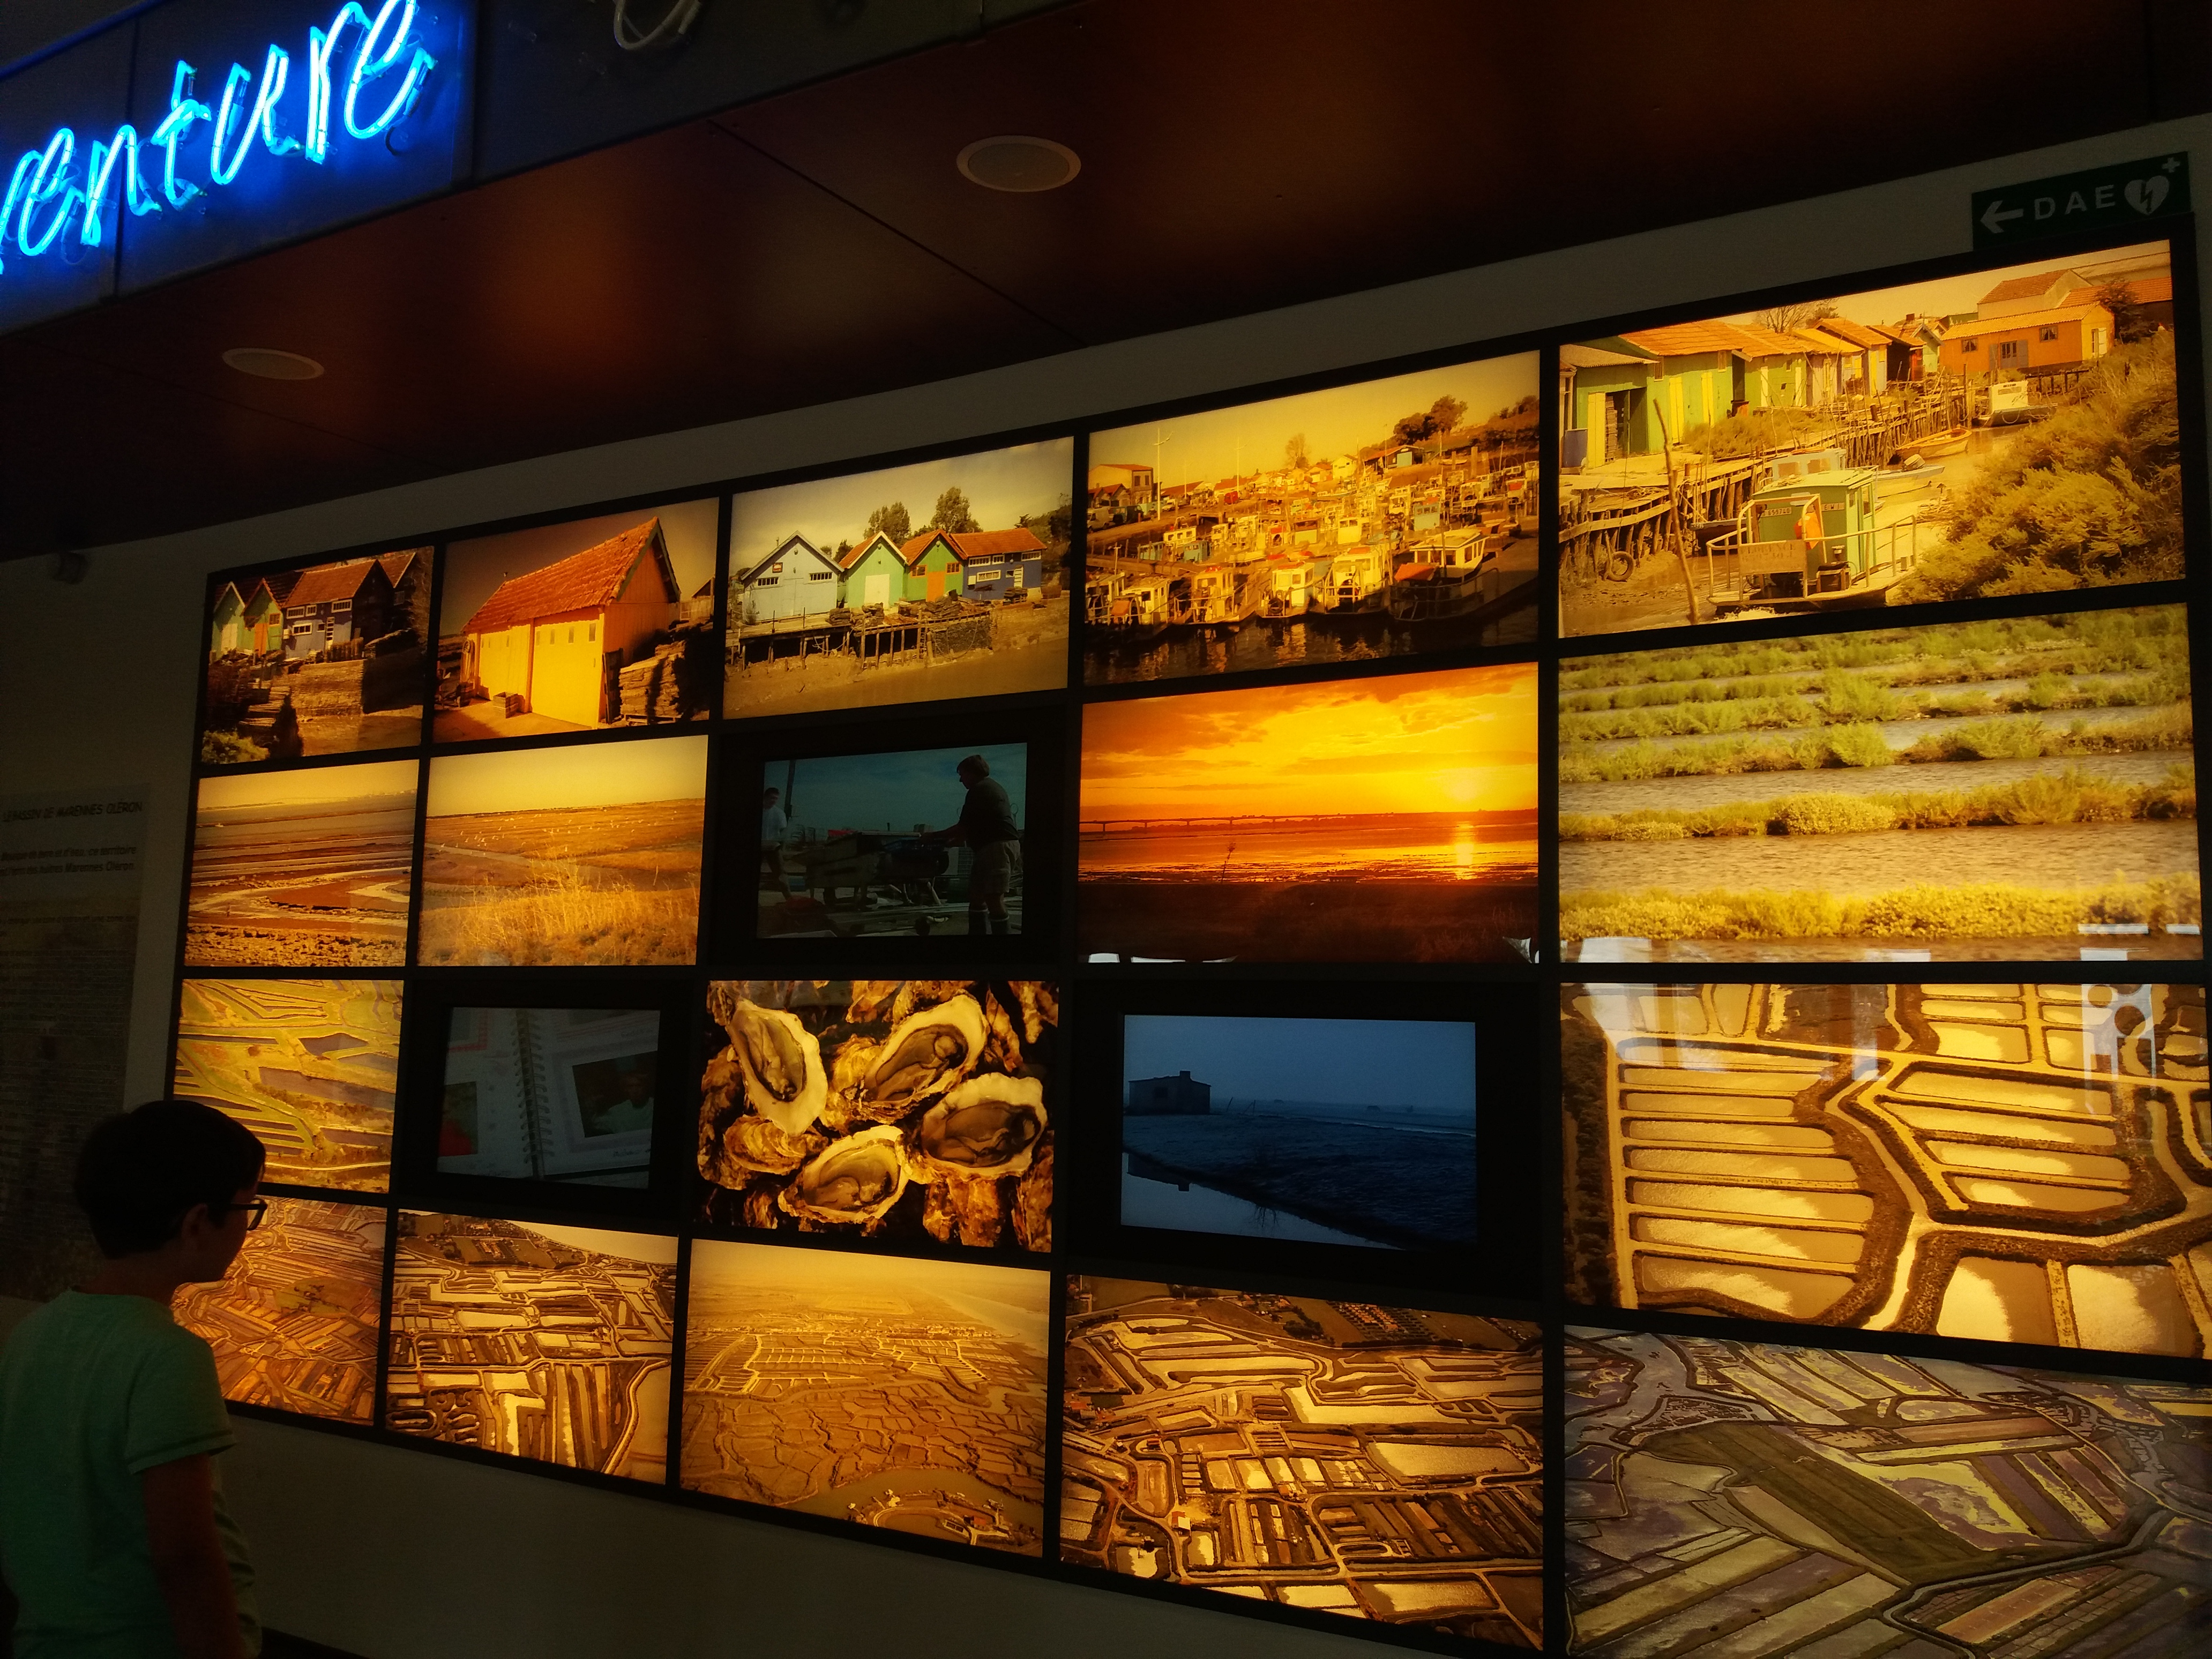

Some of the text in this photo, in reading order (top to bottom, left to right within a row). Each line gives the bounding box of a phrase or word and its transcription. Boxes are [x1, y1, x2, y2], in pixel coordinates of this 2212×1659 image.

[2034, 184, 2116, 221] DAE
[56, 803, 103, 818] MARENNES
[100, 845, 137, 856] territoire
